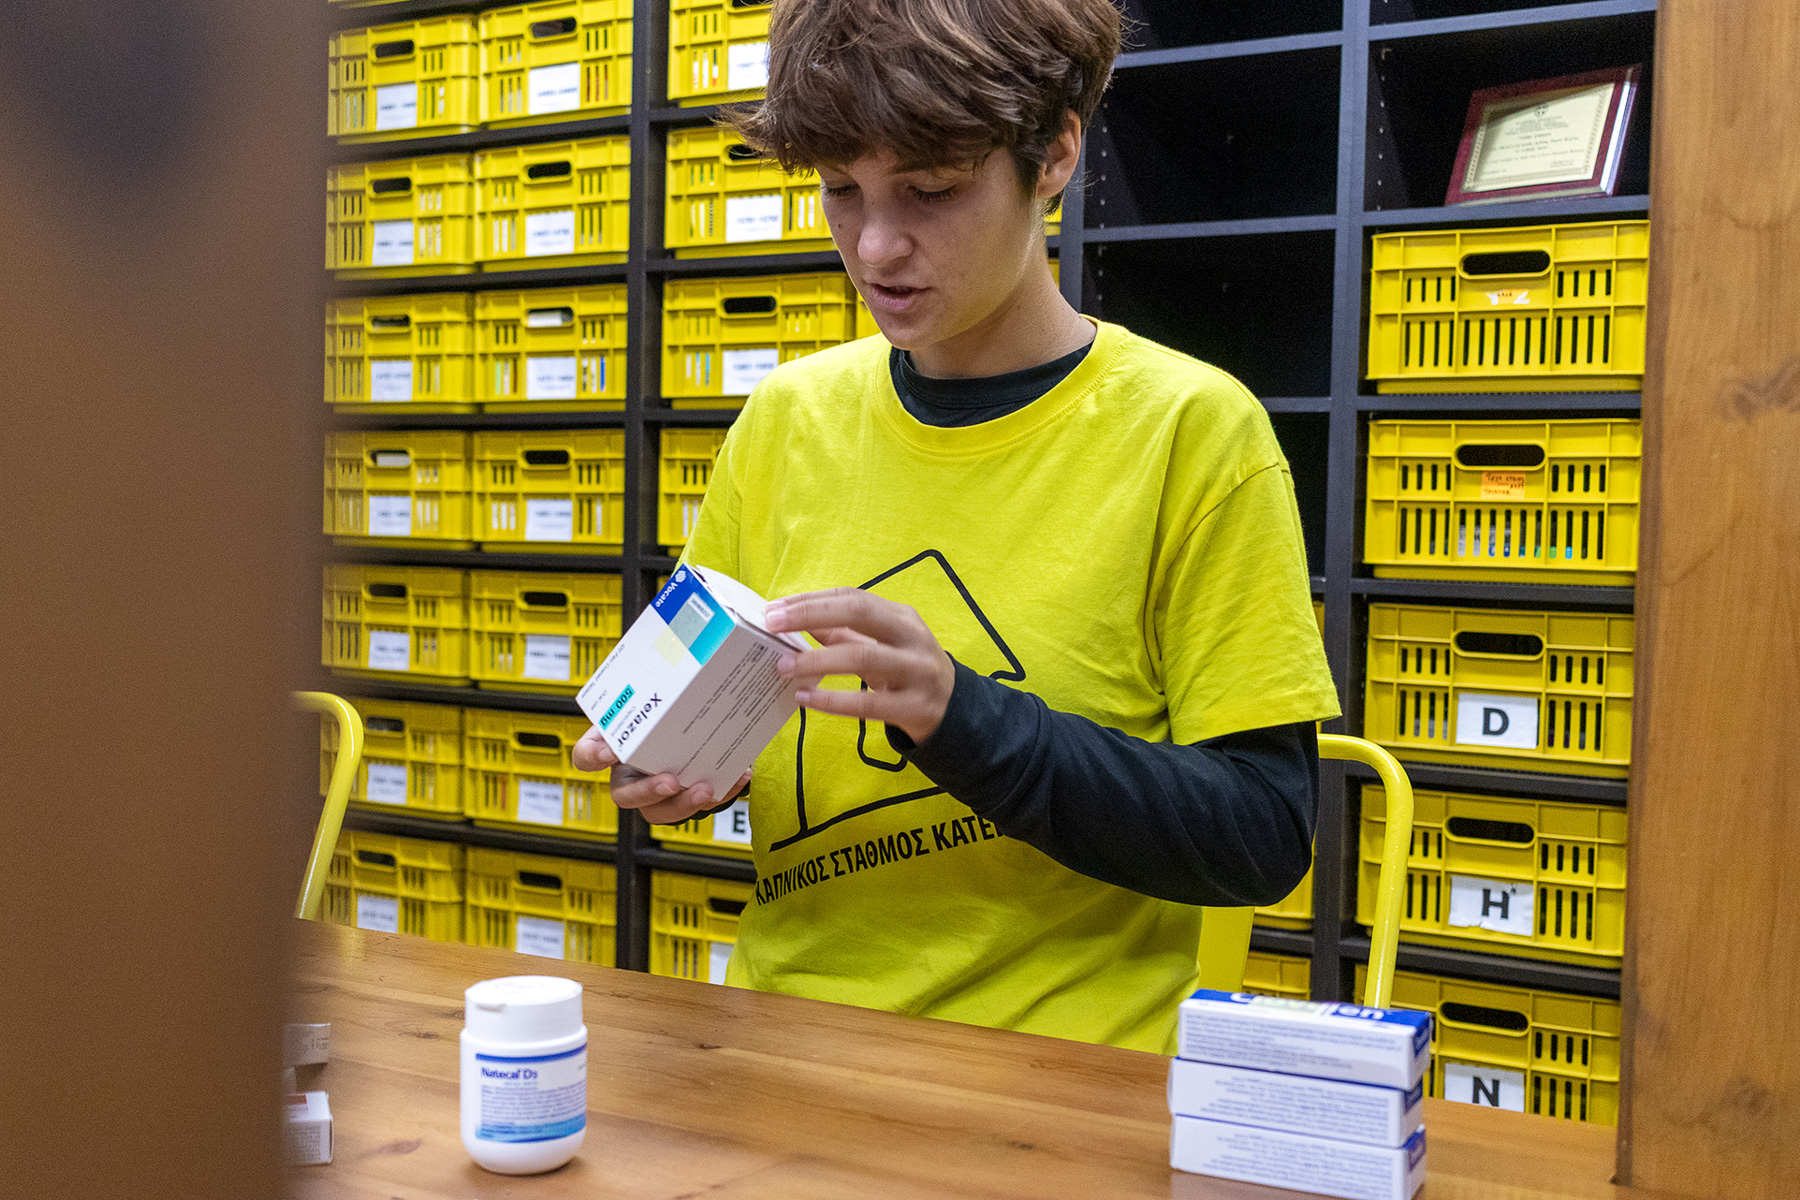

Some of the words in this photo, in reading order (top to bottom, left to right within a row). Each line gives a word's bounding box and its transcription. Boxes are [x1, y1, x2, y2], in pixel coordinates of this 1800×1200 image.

[655, 582, 678, 607] Vocate
[616, 687, 634, 709] 500
[600, 708, 615, 726] mg
[618, 692, 663, 747] Xelazor
[1482, 707, 1510, 736] D
[733, 811, 746, 834] E
[756, 855, 830, 905] ΚΑΠΝΙΚΟΣ
[830, 827, 930, 877] ΣΤΑΘΜΟΣ
[1482, 888, 1510, 919] H
[1472, 1076, 1500, 1107] N
